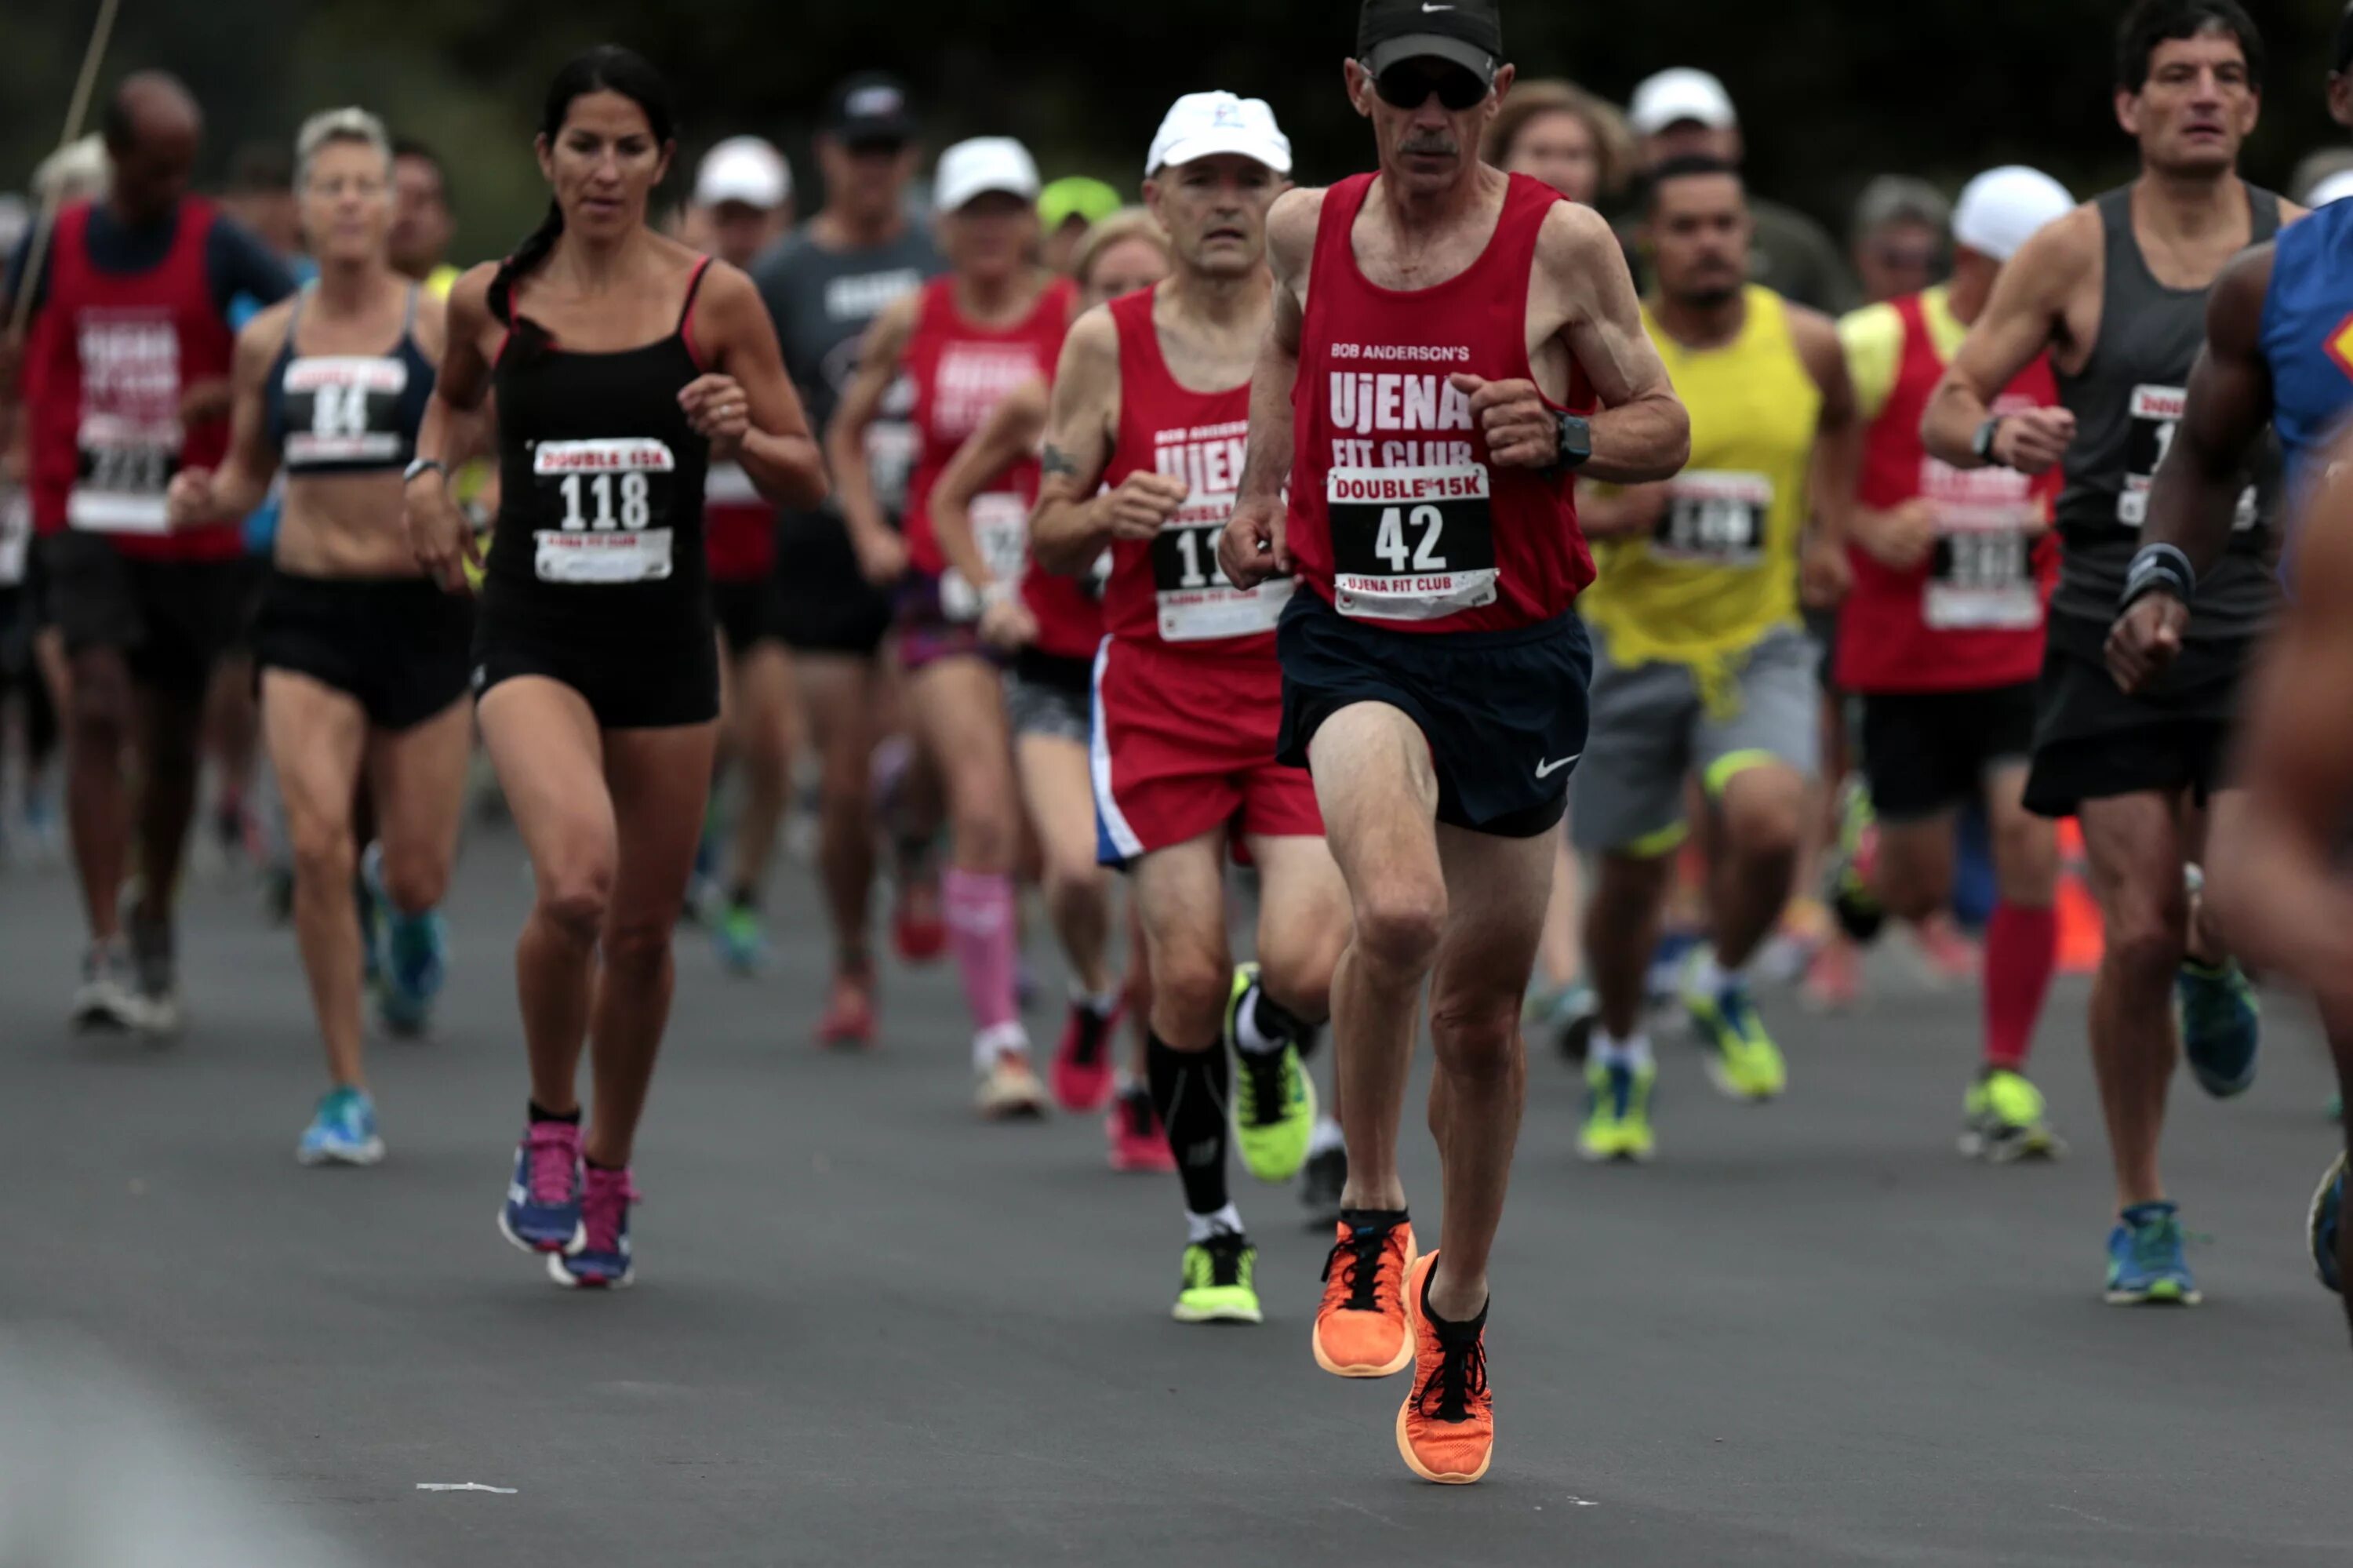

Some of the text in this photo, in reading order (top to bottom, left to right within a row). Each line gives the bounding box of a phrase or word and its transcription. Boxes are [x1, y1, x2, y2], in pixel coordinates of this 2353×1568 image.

[1331, 343, 1470, 361] BOB ANDERSON'S
[1337, 475, 1481, 499] DOUBLE 15K
[560, 471, 650, 532] 118
[1375, 504, 1447, 572] 42
[1348, 577, 1452, 592] UJENA FIT CLUB
